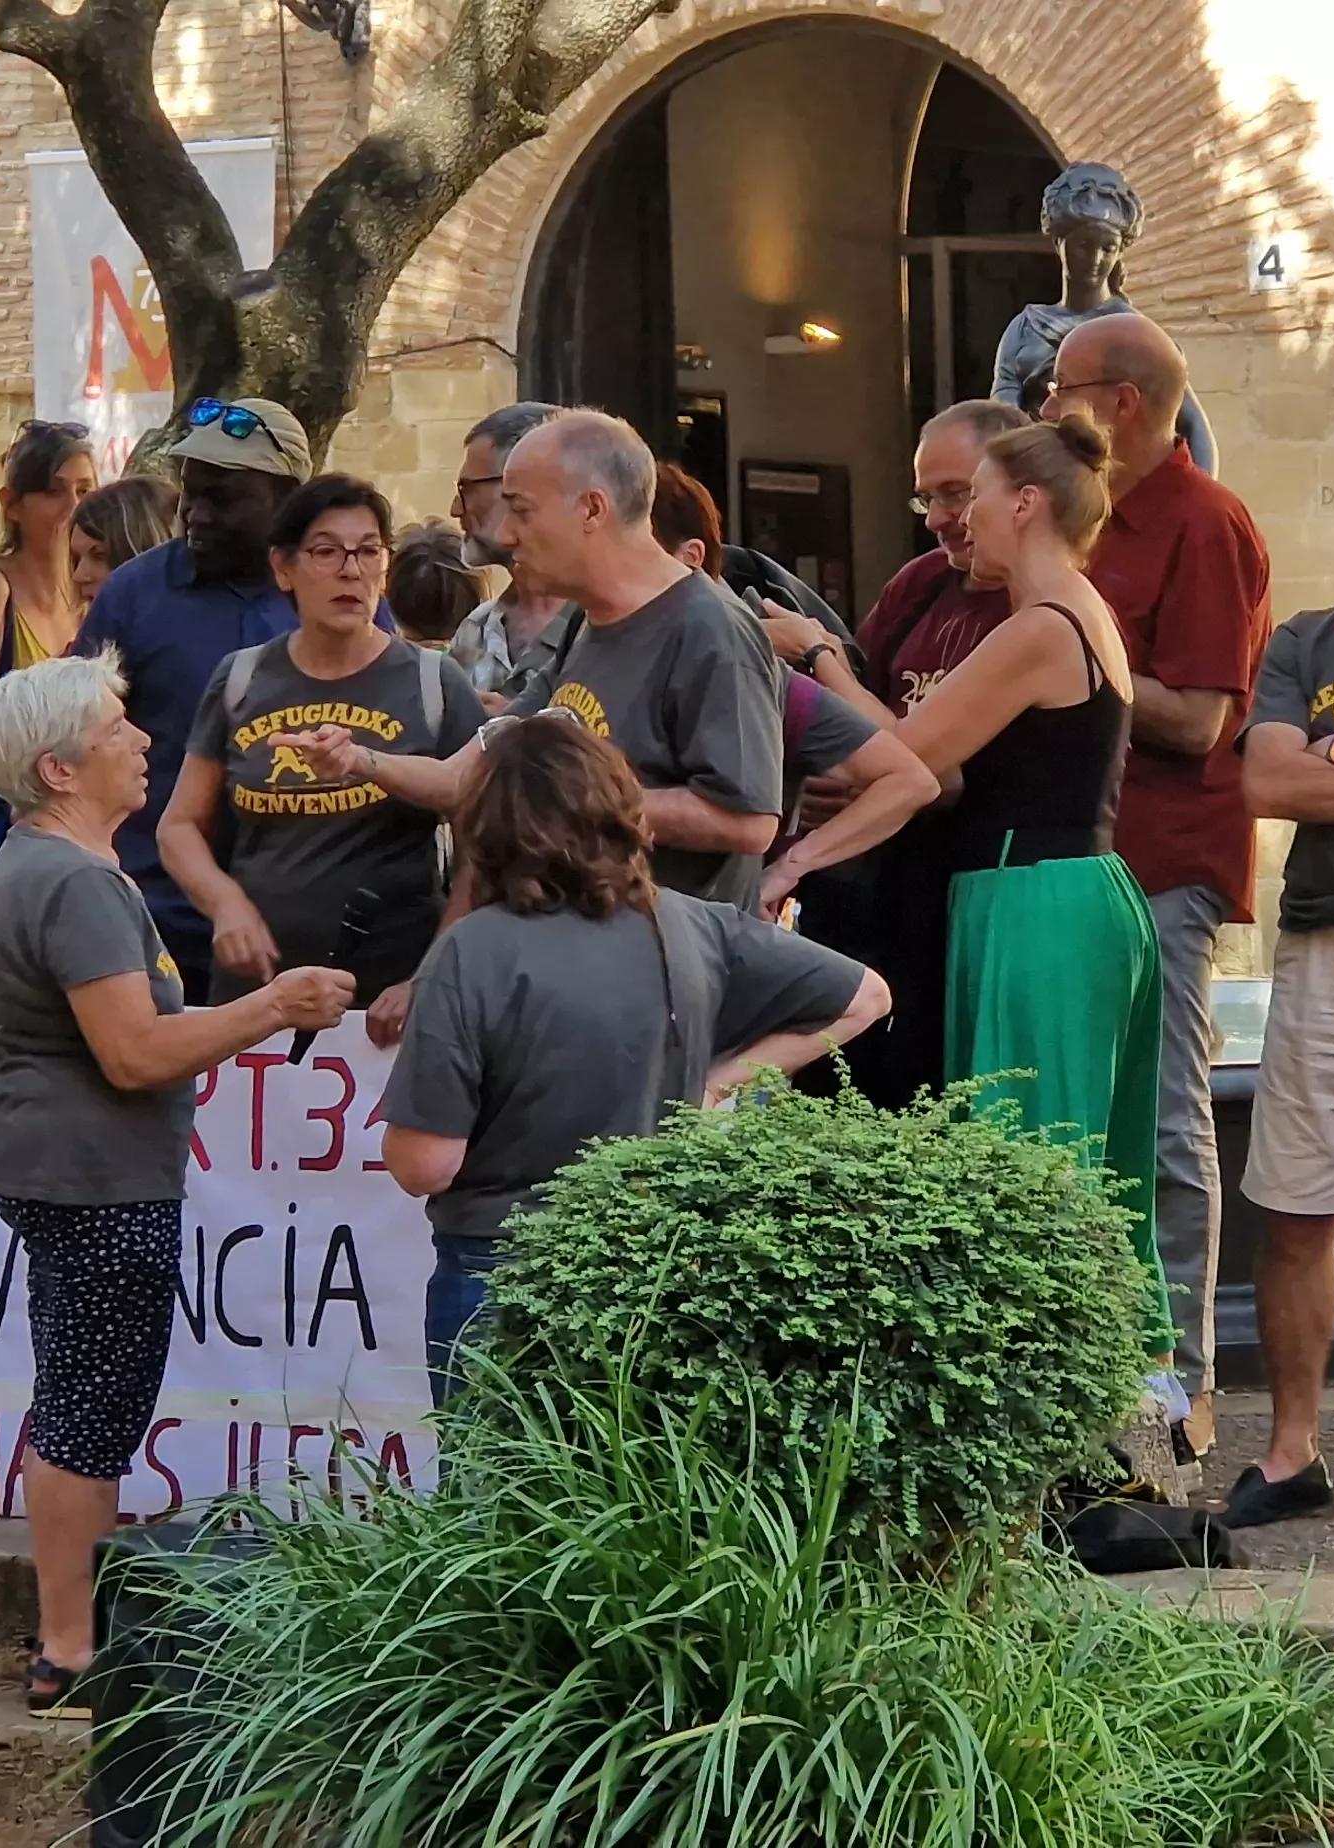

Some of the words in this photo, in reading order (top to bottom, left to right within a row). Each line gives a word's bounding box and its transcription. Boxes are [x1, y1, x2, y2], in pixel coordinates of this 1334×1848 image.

[1258, 244, 1285, 282] 4
[233, 702, 405, 752] REFUGIADXS
[233, 781, 389, 815] BIENVENIDX
